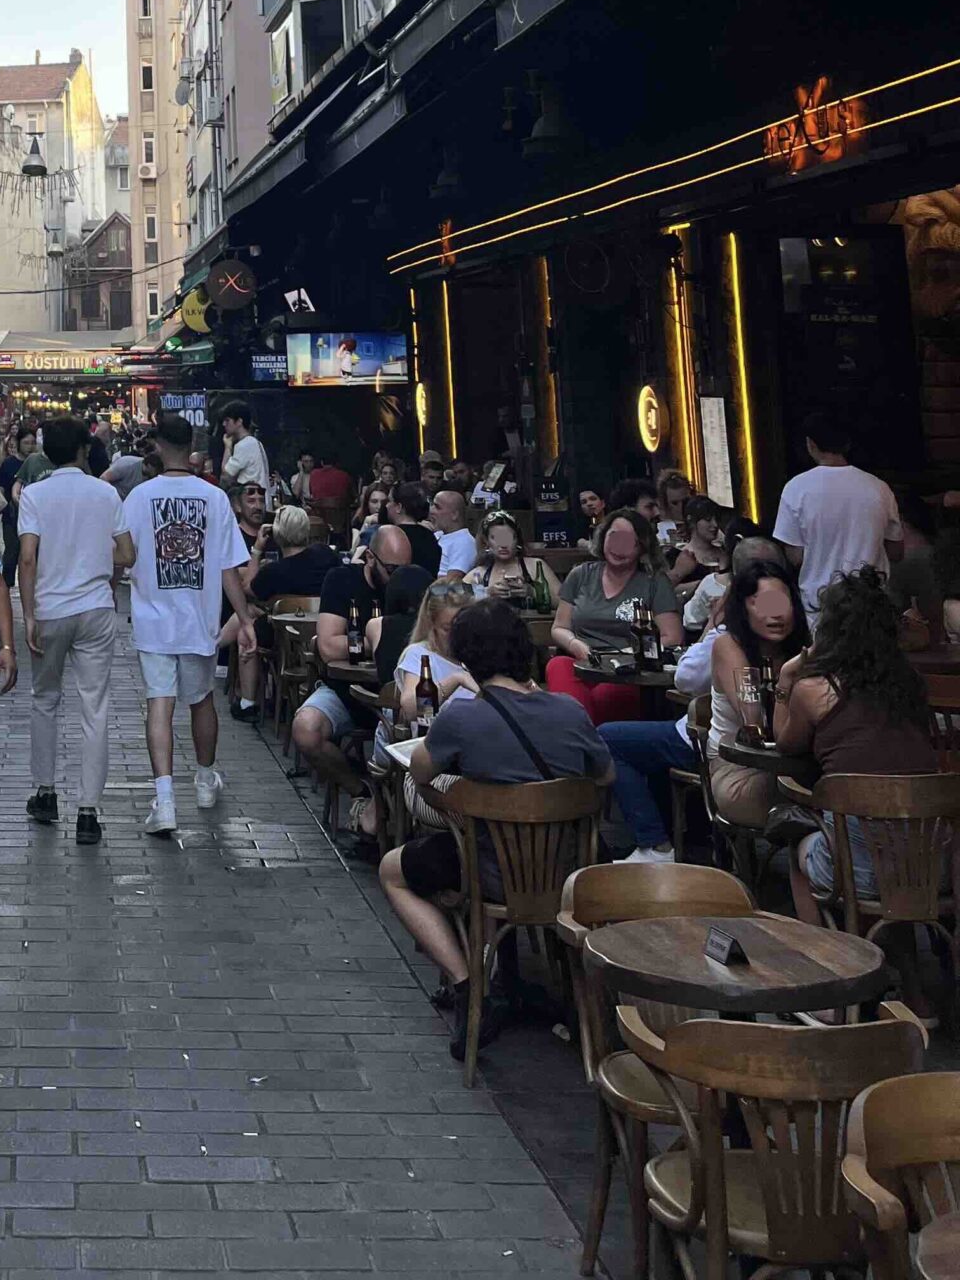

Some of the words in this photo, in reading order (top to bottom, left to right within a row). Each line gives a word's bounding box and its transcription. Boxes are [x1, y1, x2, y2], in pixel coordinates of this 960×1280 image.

[160, 392, 183, 409] TÜM
[184, 392, 206, 409] GÜN
[152, 498, 206, 530] KADER
